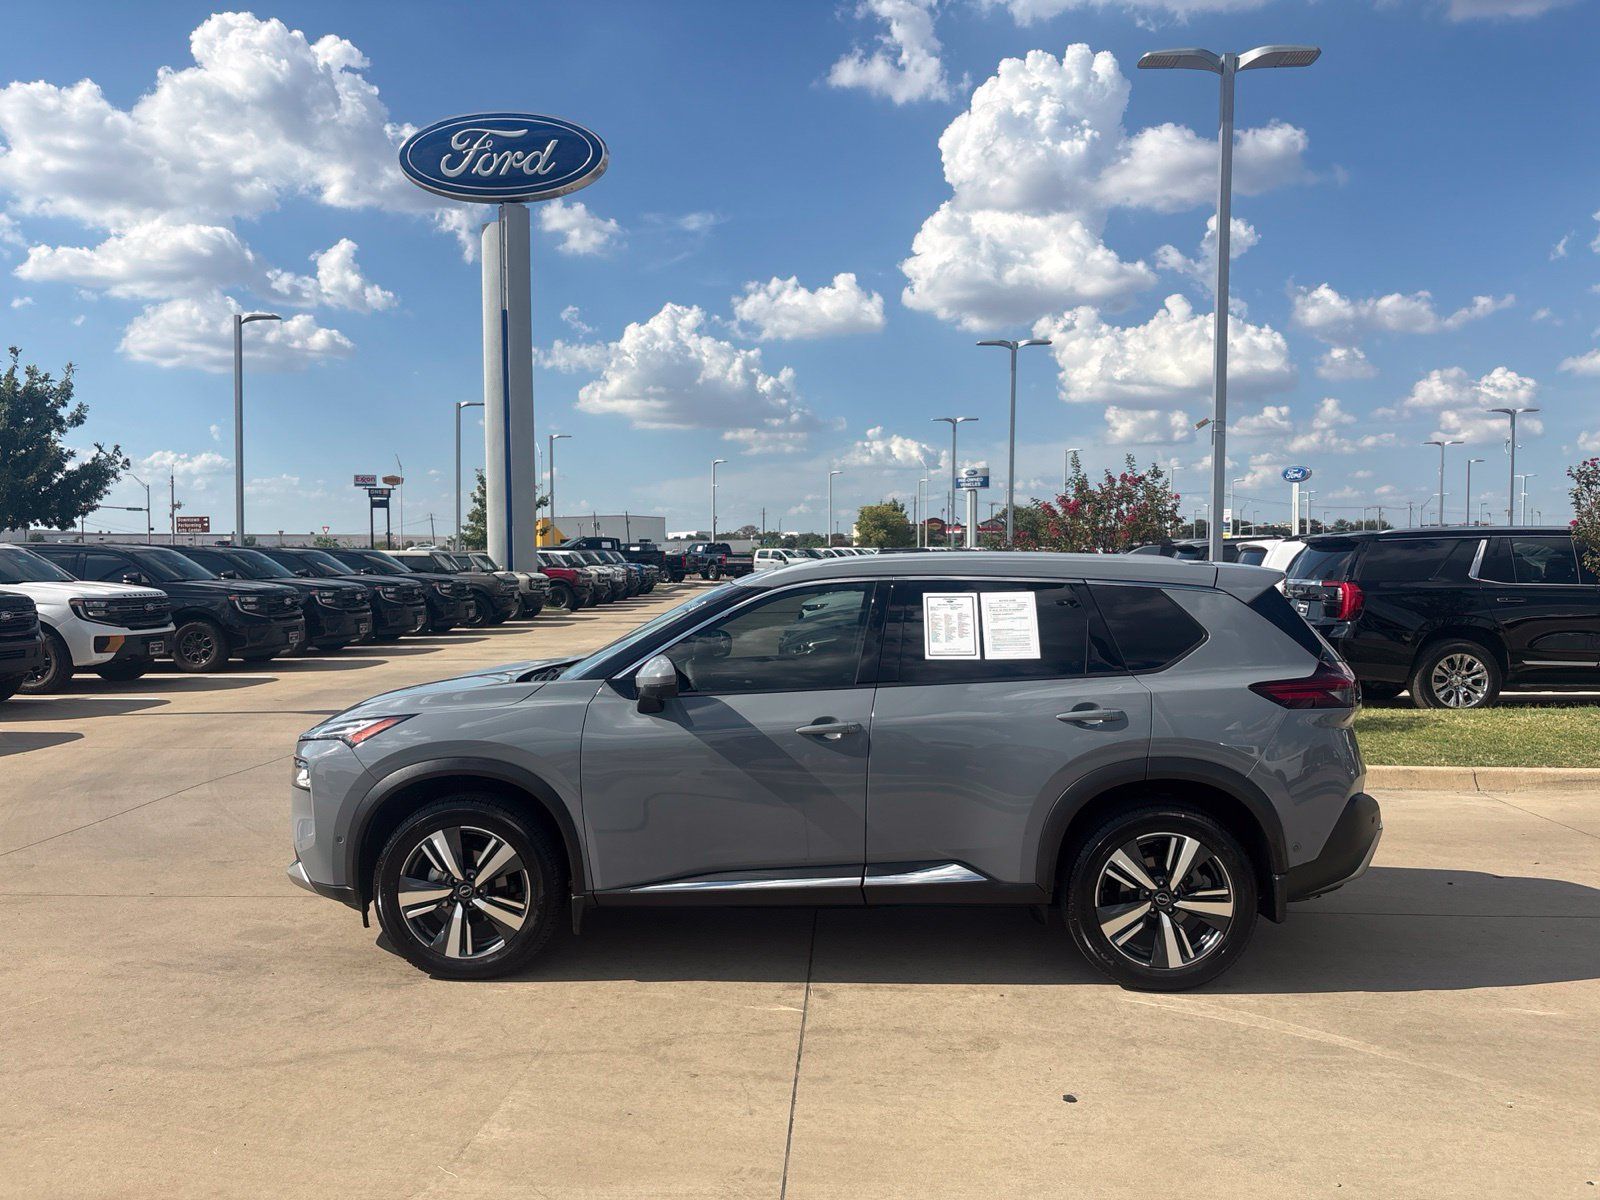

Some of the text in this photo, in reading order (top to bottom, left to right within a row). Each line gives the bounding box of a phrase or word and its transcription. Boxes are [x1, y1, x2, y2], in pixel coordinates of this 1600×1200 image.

[440, 128, 559, 178] Ford
[1285, 469, 1303, 479] Ford
[355, 475, 376, 484] Exxon
